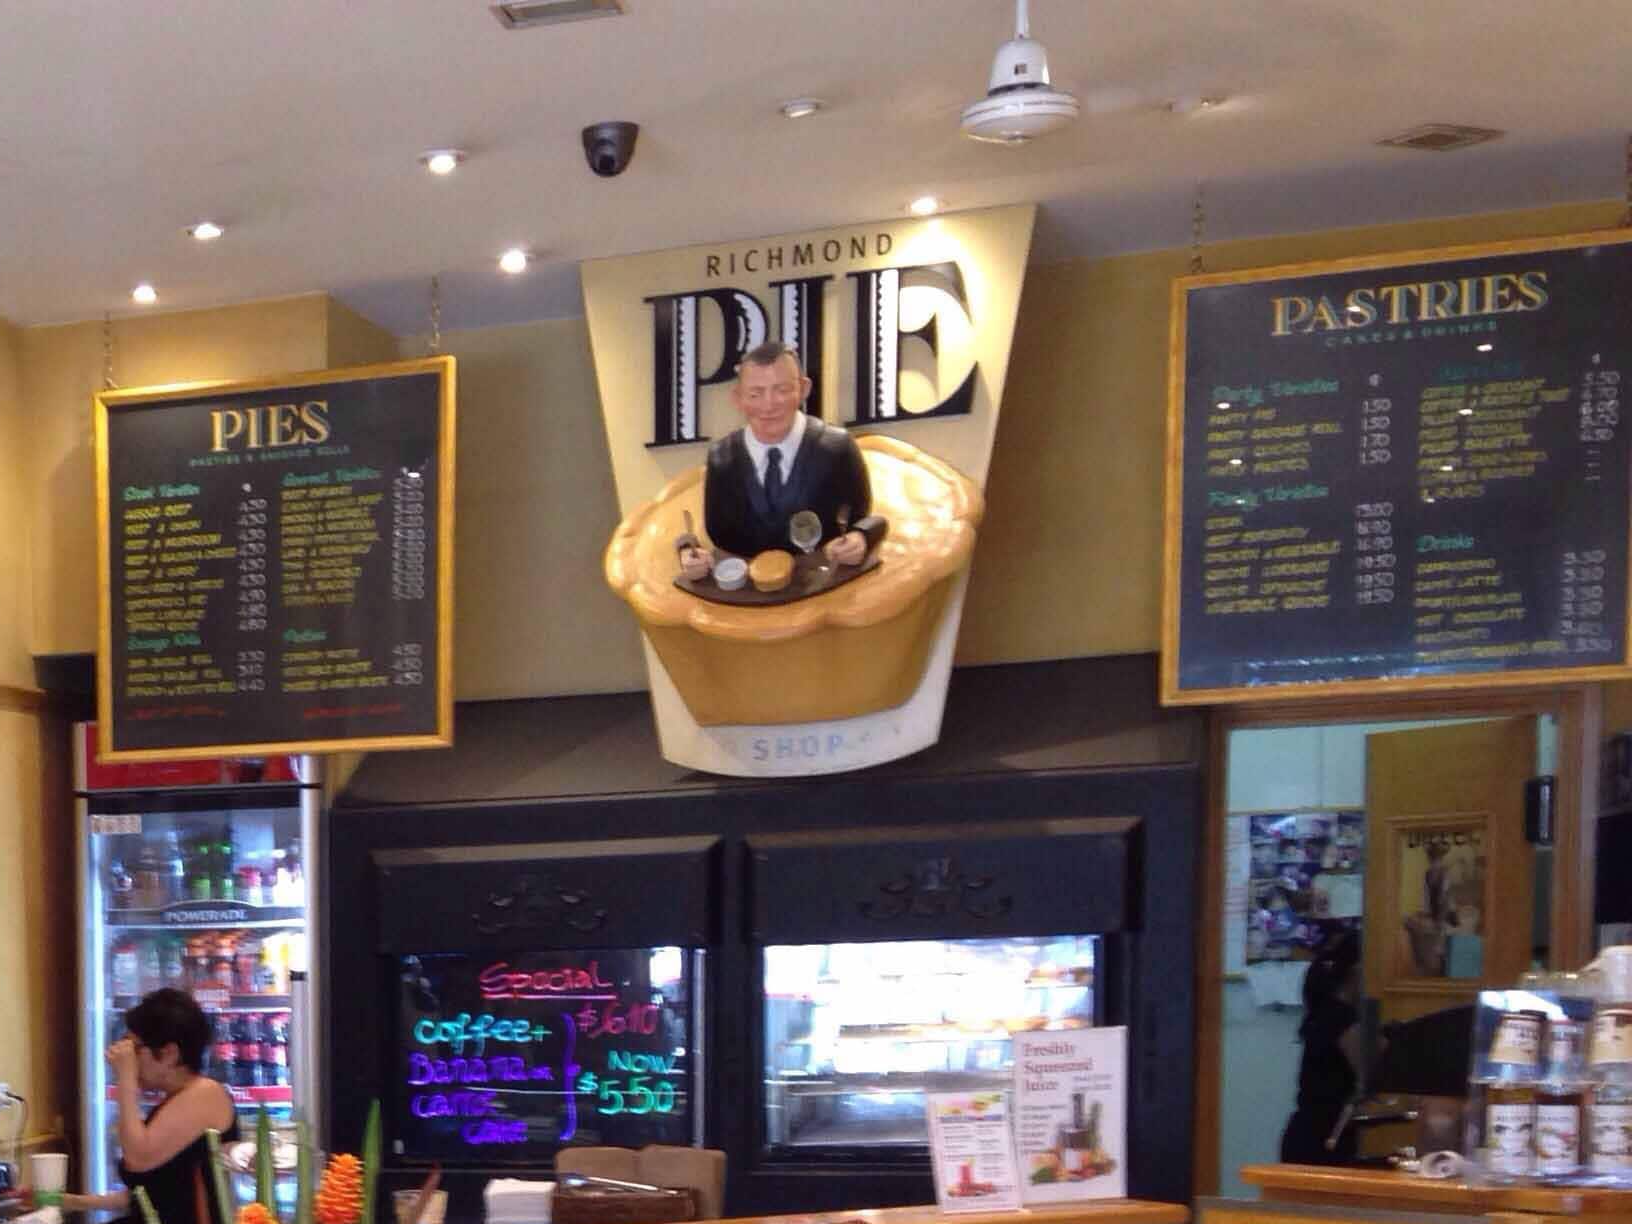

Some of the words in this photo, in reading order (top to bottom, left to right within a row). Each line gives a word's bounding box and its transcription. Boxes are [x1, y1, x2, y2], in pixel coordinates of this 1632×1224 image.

[706, 232, 894, 278] RICHMOND
[1271, 270, 1550, 337] PASTRIES
[643, 260, 980, 448] PIE
[210, 400, 330, 452] PIES
[751, 733, 844, 761] SHOP
[479, 960, 614, 992] Special
